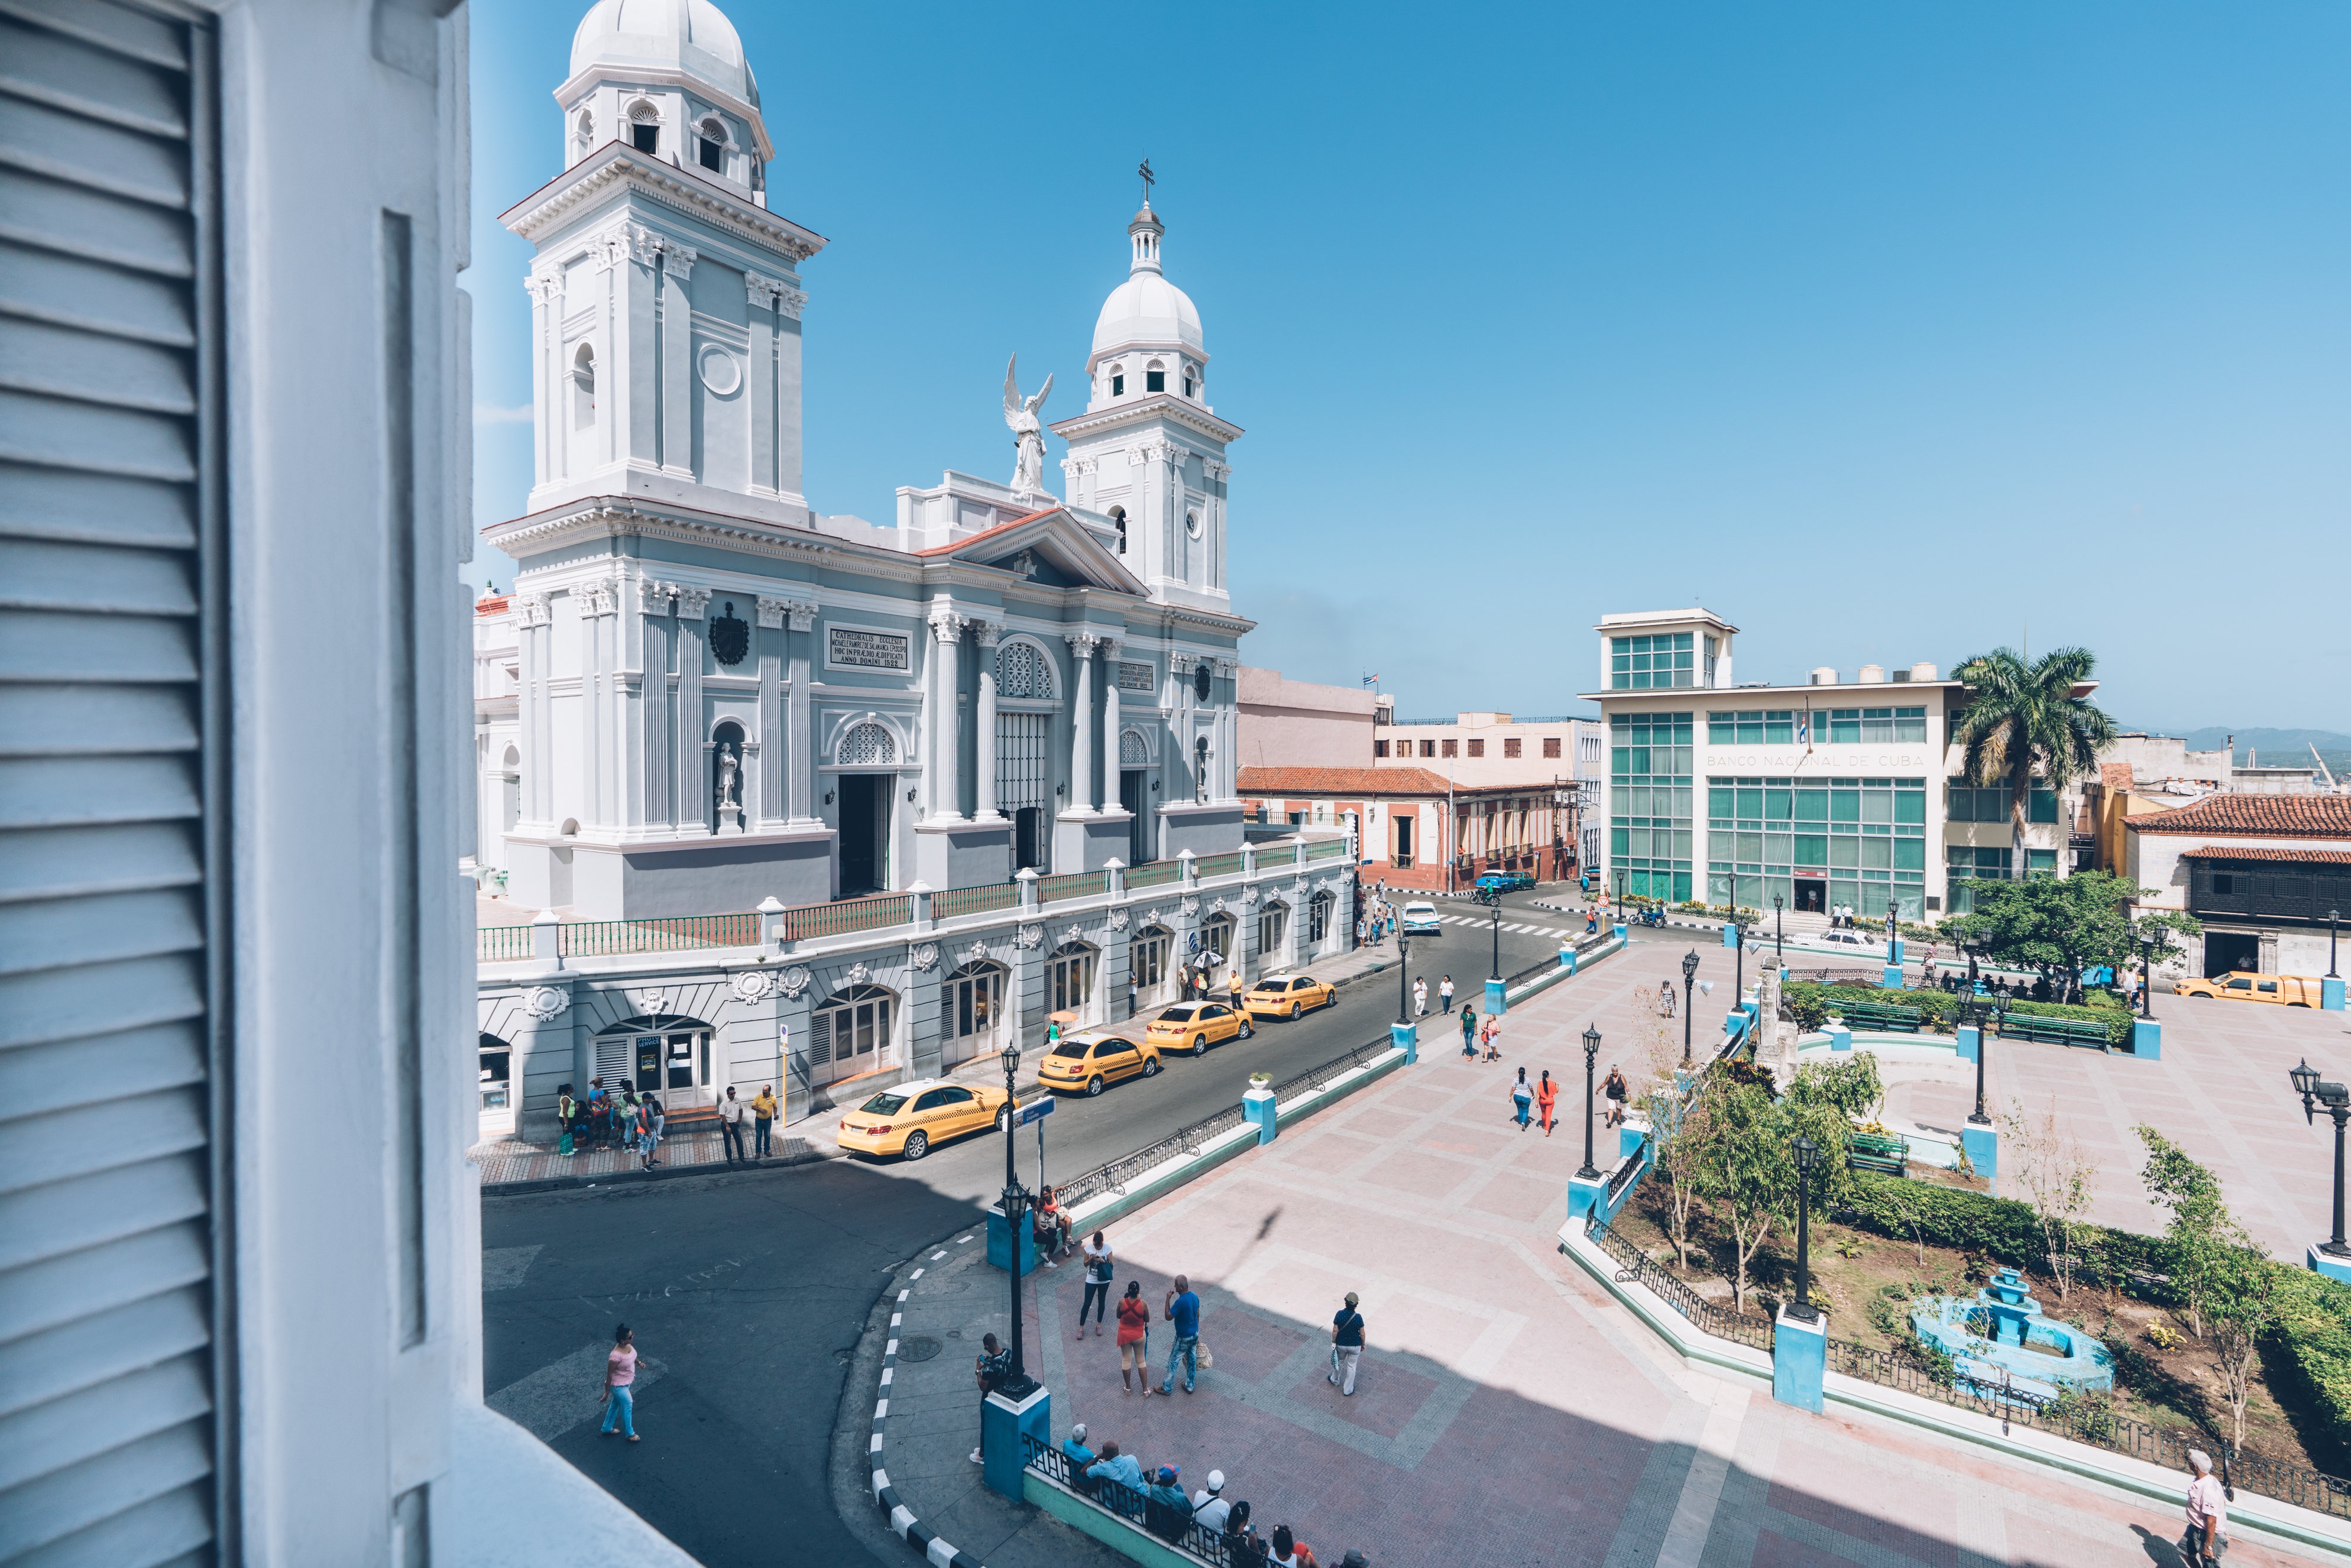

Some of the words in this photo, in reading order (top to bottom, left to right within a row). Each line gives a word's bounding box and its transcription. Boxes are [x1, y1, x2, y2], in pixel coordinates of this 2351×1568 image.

[832, 639, 849, 647] MICHAELE
[836, 631, 873, 642] CATHEDRALIS
[880, 637, 902, 645] ECCLESIA
[1708, 756, 1756, 766] BANCO
[1764, 756, 1841, 766] NACIONAL
[1850, 756, 1869, 766] DE
[1879, 756, 1924, 766] CUBA
